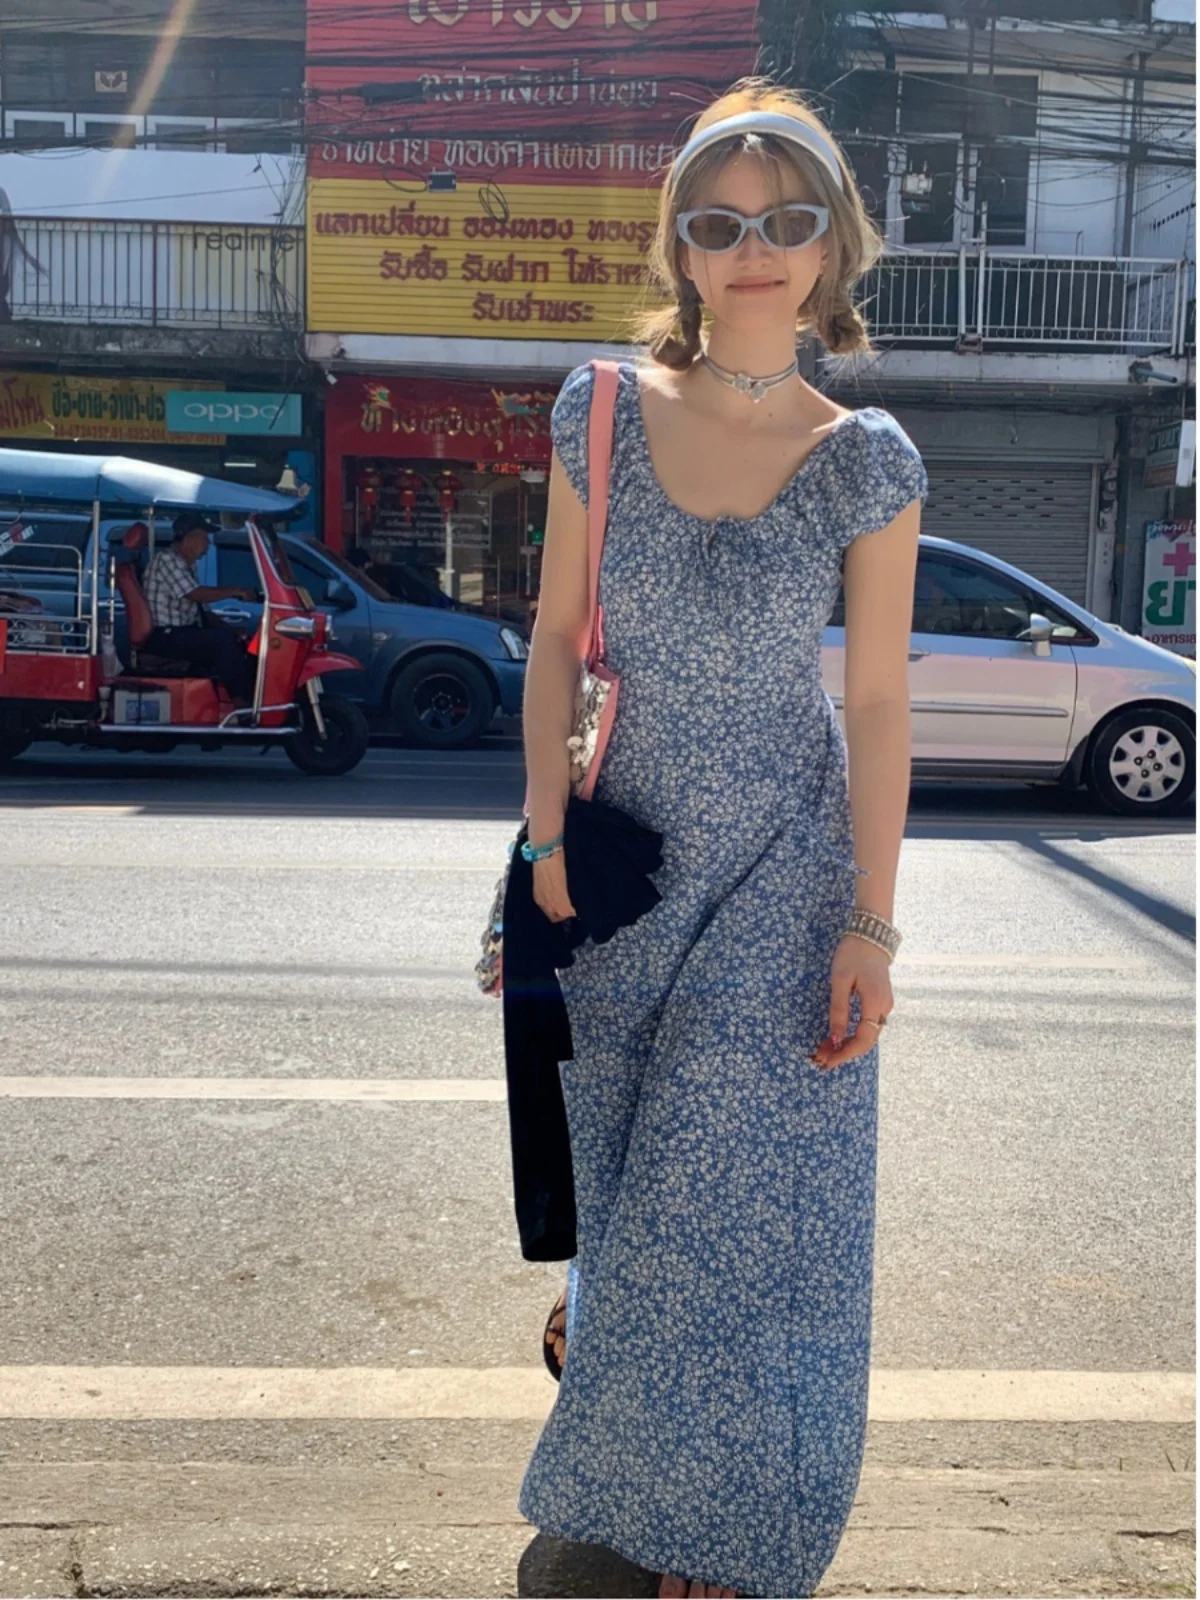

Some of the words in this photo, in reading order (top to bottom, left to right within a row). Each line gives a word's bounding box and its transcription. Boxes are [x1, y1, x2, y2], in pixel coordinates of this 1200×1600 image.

[193, 231, 295, 252] reame
[315, 201, 450, 237] แลกเปลี่ยน
[588, 219, 659, 253] ทองรู
[379, 244, 448, 281] รับซื้อ
[461, 252, 549, 283] รับฝาก
[472, 291, 594, 323] รับเช่าพระ
